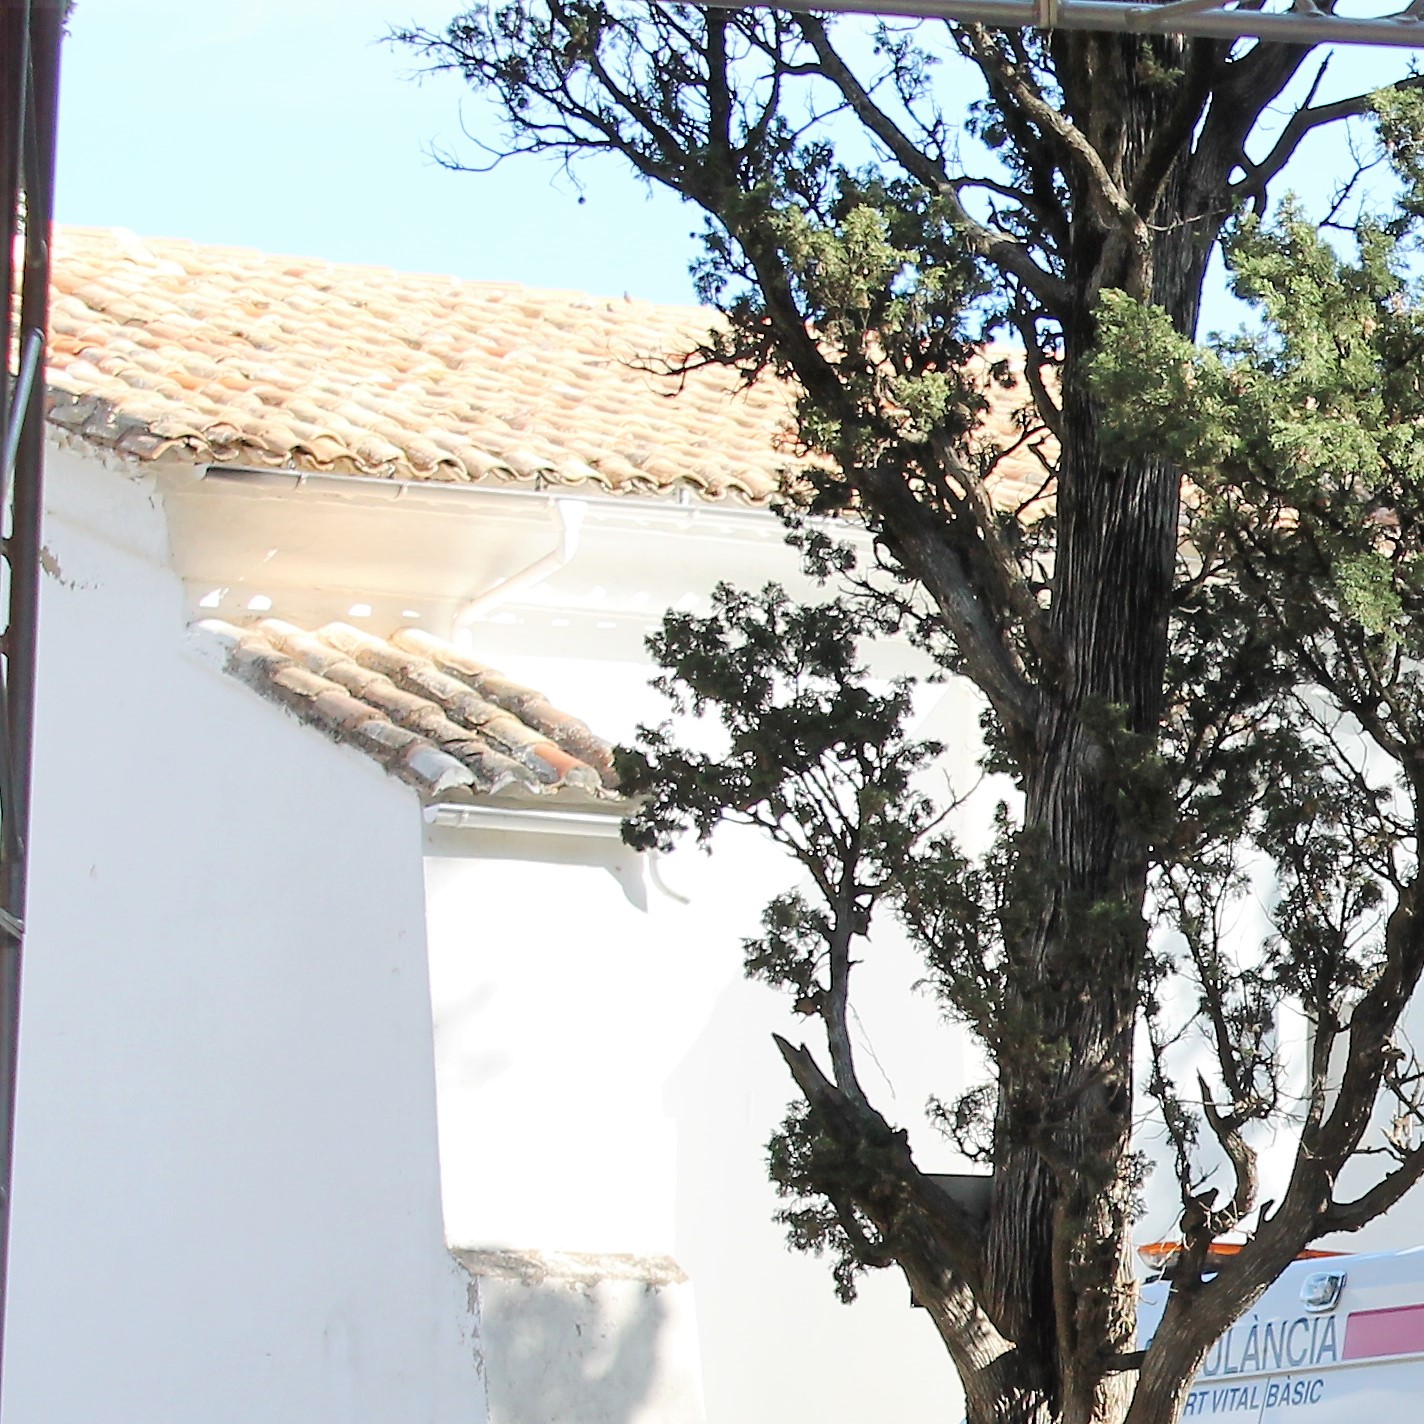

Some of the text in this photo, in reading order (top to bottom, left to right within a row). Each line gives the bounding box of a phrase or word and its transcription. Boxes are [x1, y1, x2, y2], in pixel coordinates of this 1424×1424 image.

[1203, 1314, 1338, 1377] ULÀNCIA
[1212, 1386, 1260, 1414] VITAL
[1265, 1375, 1324, 1409] BÀSIC
